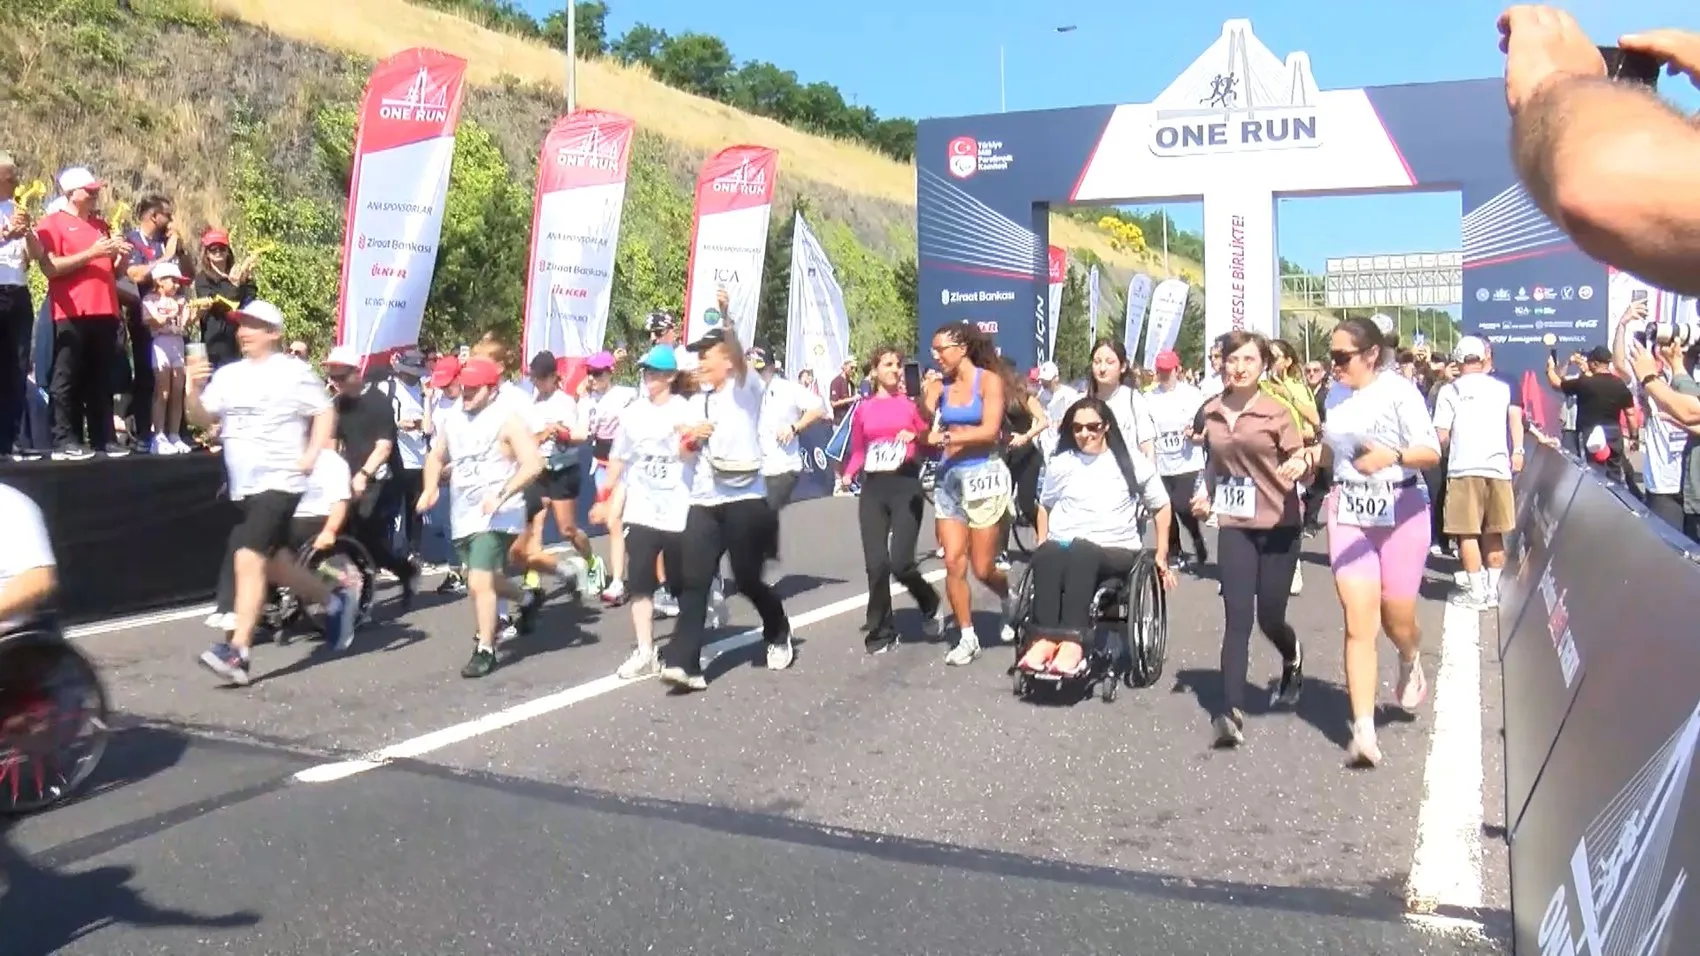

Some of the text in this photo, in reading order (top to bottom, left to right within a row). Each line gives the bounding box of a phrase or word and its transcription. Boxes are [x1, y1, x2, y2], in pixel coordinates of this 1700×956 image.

[380, 107, 447, 122] ONE RUN
[1155, 116, 1316, 149] ONE RUN
[557, 154, 619, 173] ONE RUN
[713, 183, 766, 195] ONE RUN
[1229, 215, 1245, 280] BİRLİKTE!
[950, 292, 978, 303] Ziraat
[1223, 487, 1245, 506] 158
[1345, 495, 1387, 517] 5502
